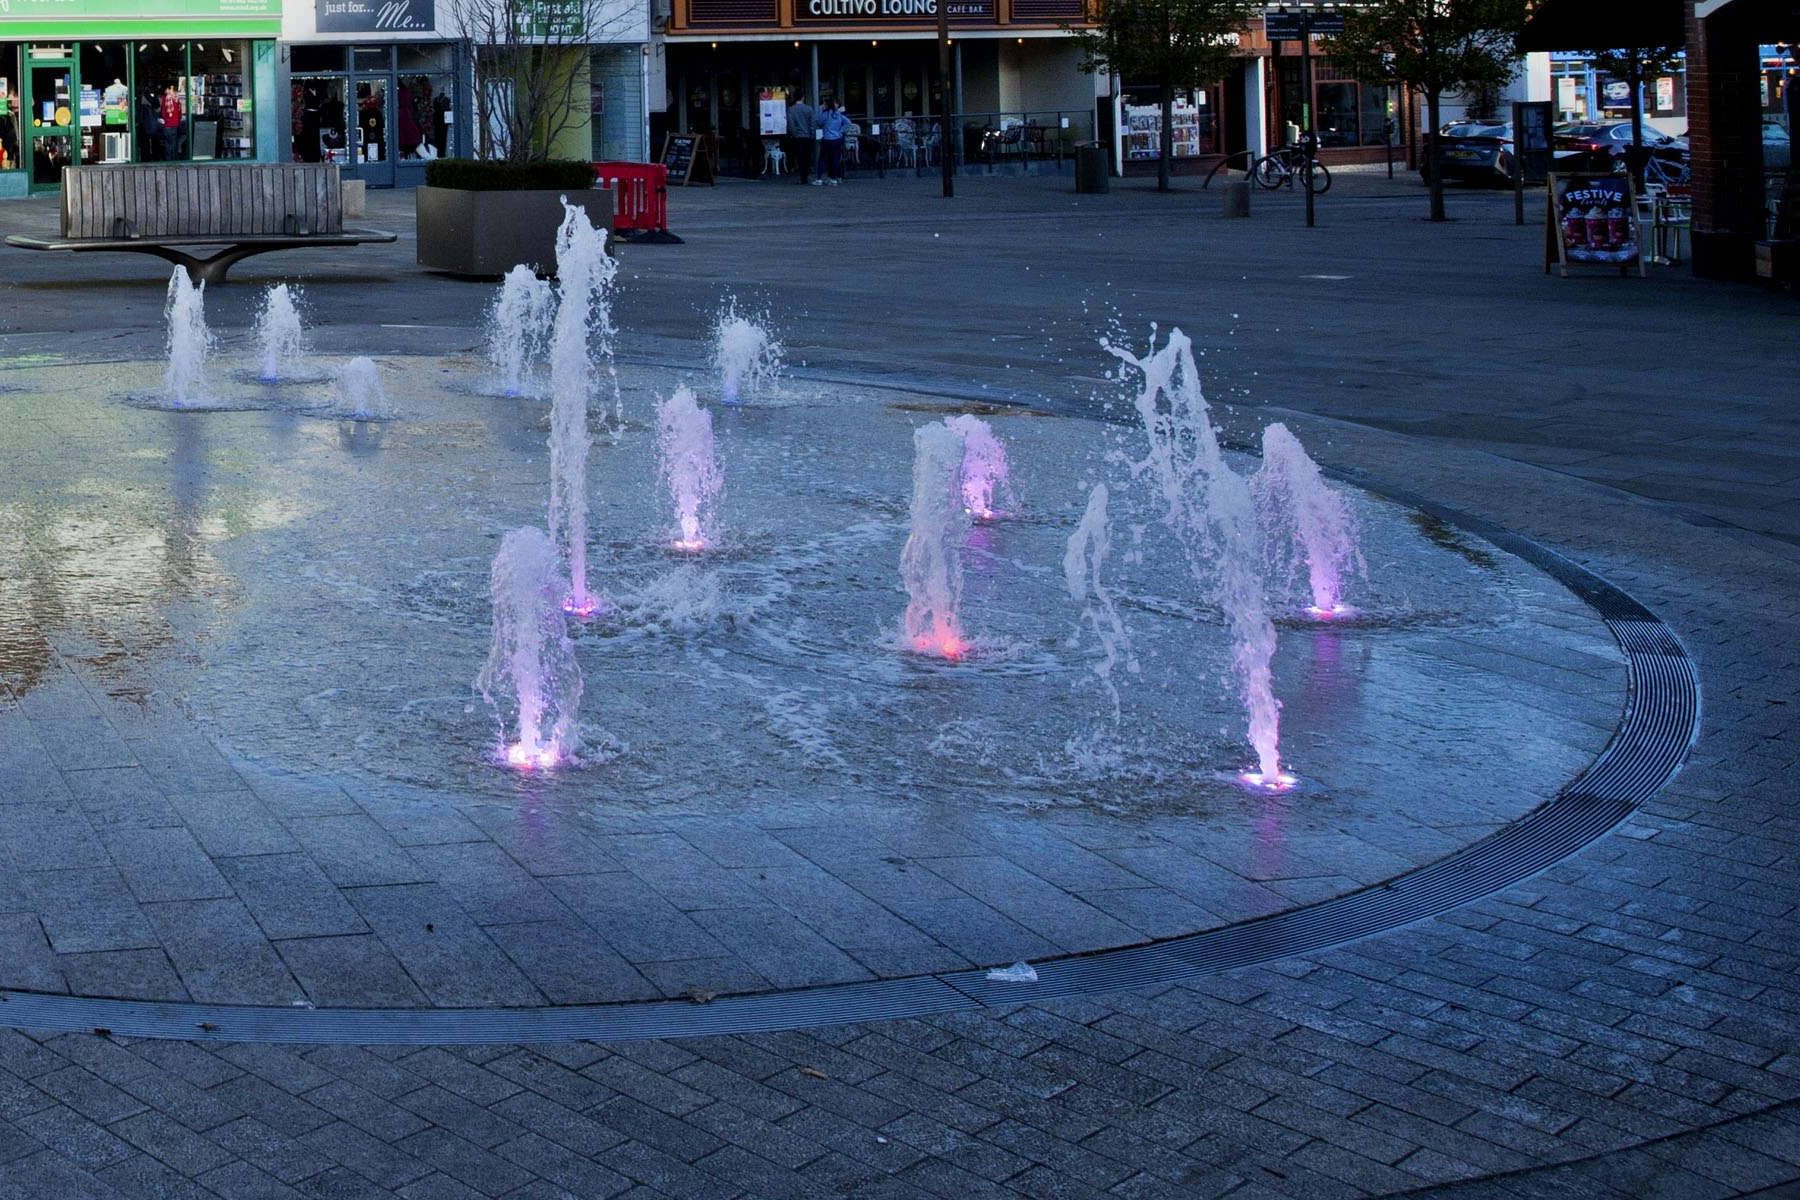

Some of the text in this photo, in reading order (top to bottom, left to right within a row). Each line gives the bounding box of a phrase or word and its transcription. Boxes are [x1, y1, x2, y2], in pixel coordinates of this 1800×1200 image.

[325, 1, 346, 16] just
[348, 1, 374, 13] for...
[564, 1, 581, 14] aid
[810, 0, 877, 14] CULTIVO
[882, 0, 937, 14] LOUNG
[947, 5, 966, 13] CAFÉ
[1565, 189, 1623, 203] FESTIVE
